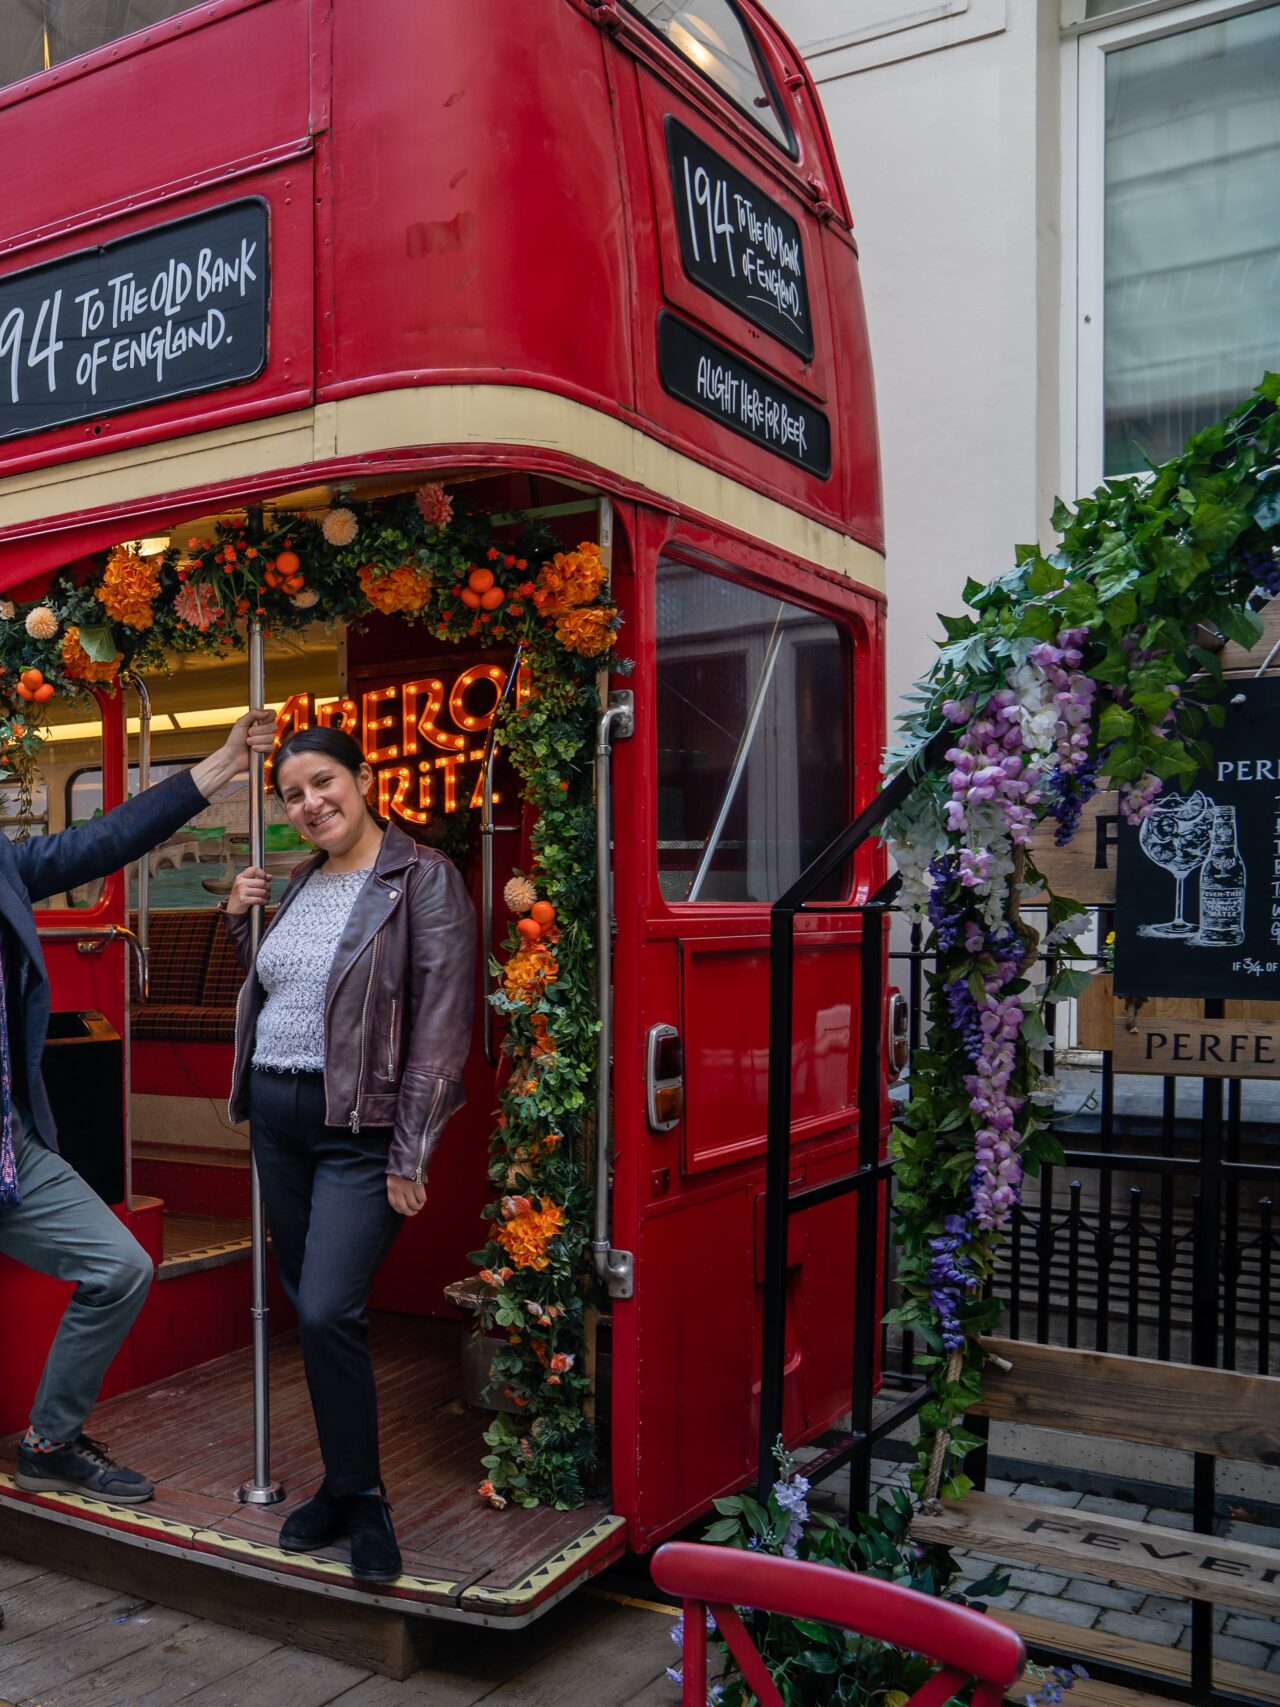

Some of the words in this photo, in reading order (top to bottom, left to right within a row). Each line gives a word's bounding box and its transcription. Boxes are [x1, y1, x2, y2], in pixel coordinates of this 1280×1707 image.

[684, 155, 736, 278] 194
[742, 248, 756, 285] OF
[777, 226, 801, 276] BANK
[75, 288, 105, 338] TO
[107, 272, 148, 329] THE
[150, 258, 192, 317] OLD
[196, 238, 257, 302] BANK
[75, 338, 111, 396] OF
[697, 355, 739, 414] ALIGHT
[740, 379, 764, 432] HERE
[764, 396, 780, 440] FOR
[781, 403, 808, 458] BEER
[1217, 760, 1280, 782] PER
[1232, 961, 1242, 971] IF
[1266, 962, 1279, 972] OF
[1144, 1032, 1276, 1064] PERFE
